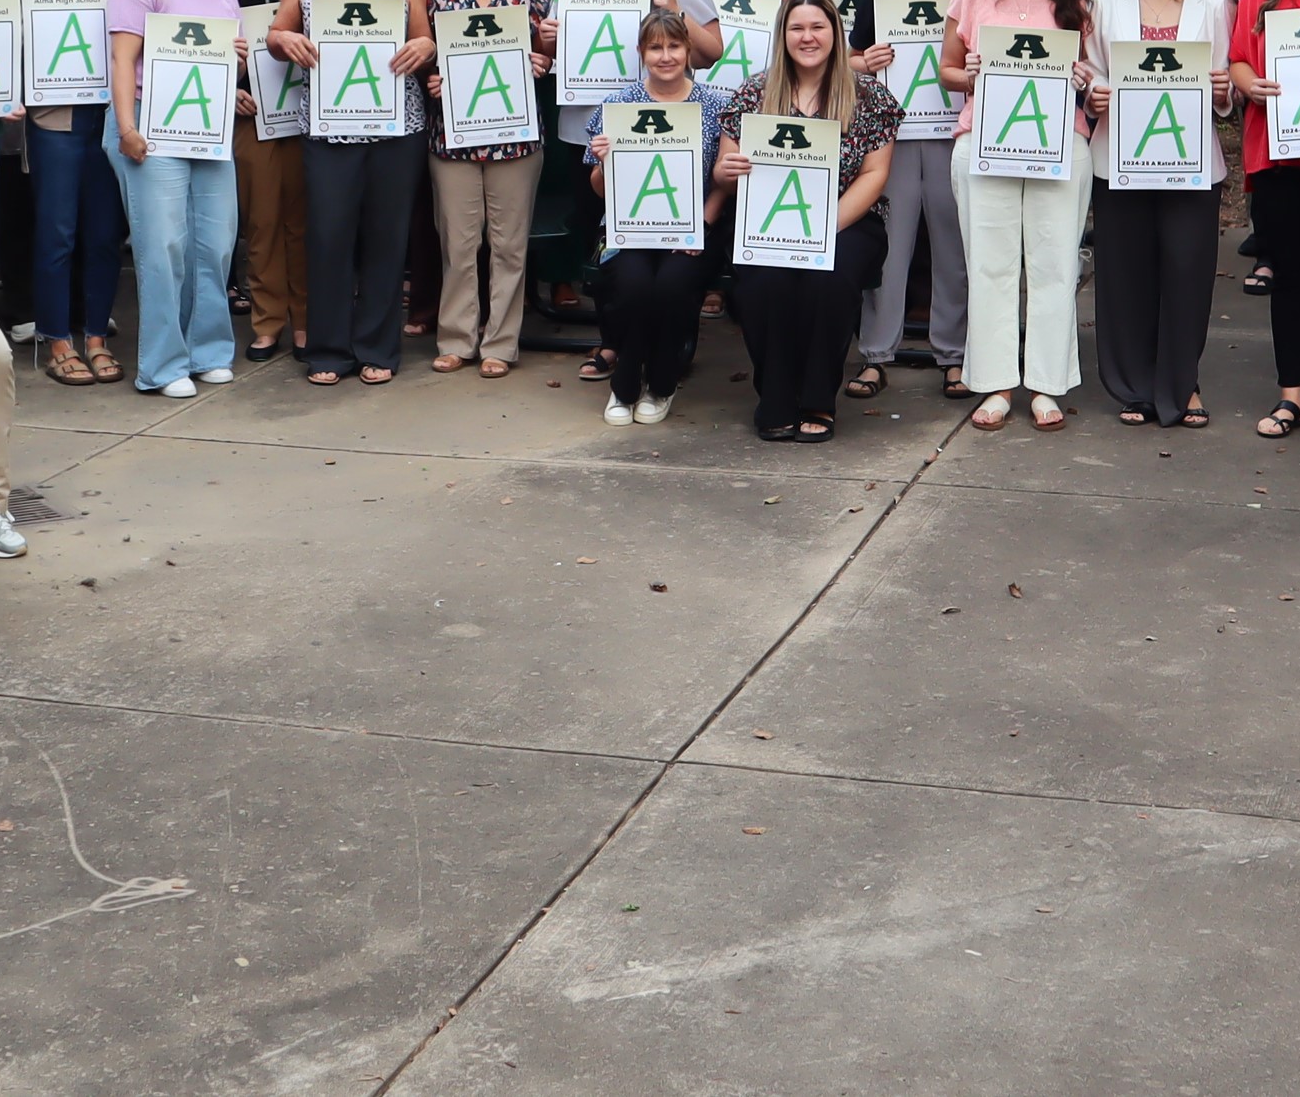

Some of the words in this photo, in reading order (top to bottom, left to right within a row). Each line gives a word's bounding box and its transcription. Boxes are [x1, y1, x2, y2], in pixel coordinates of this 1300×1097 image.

[337, 2, 377, 26] A
[463, 13, 503, 37] A
[745, 18, 769, 26] School
[902, 1, 944, 25] A
[47, 12, 94, 75] A
[172, 20, 211, 46] A
[345, 29, 363, 37] High
[472, 39, 490, 48] High
[492, 37, 518, 45] School
[578, 13, 626, 76] A
[911, 28, 931, 37] High
[1006, 32, 1049, 59] A
[179, 48, 197, 57] High
[199, 49, 225, 57] School
[989, 60, 1011, 68] Alma
[1013, 62, 1033, 71] High
[1036, 63, 1064, 71] School
[1138, 46, 1182, 72] A
[333, 45, 382, 107] A
[466, 54, 514, 118] A
[901, 44, 952, 109] A
[1147, 75, 1167, 84] High
[162, 65, 211, 130] A
[631, 108, 673, 134] A
[995, 79, 1048, 148] A
[1133, 92, 1187, 159] A
[639, 137, 659, 145] High
[769, 123, 811, 149] A
[776, 152, 796, 160] High
[798, 153, 826, 161] School
[629, 153, 680, 219] A
[759, 169, 811, 238] A
